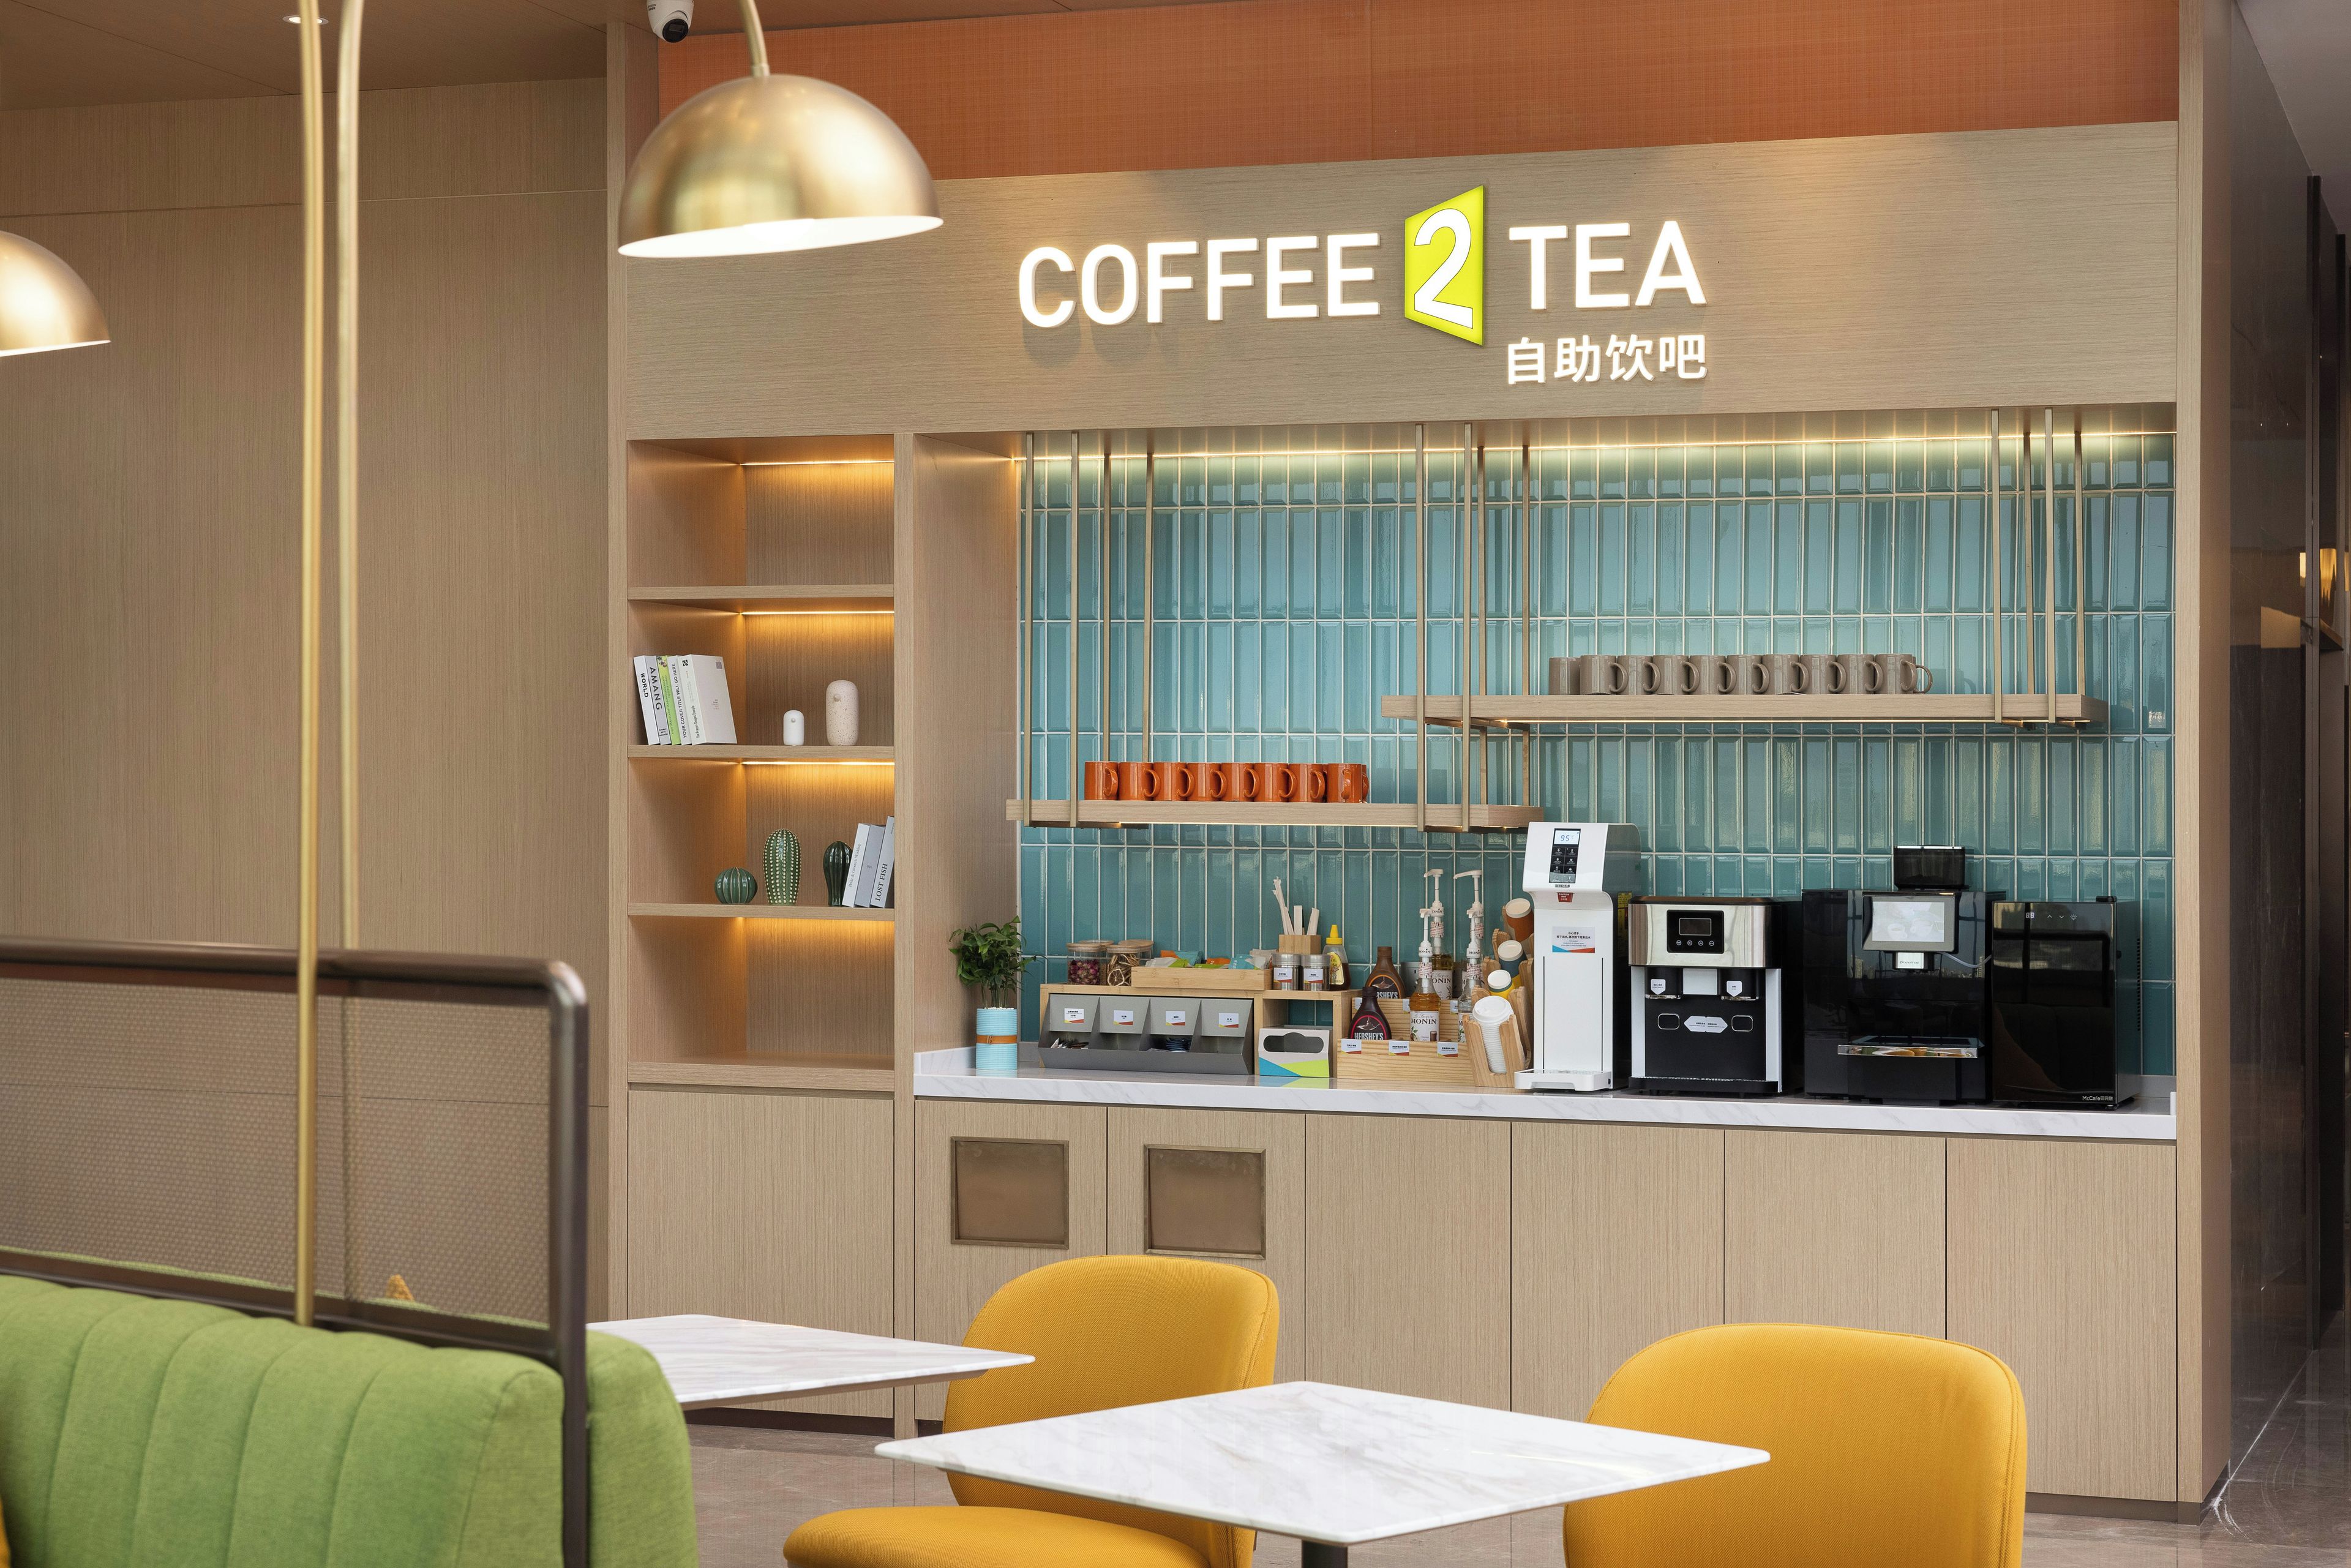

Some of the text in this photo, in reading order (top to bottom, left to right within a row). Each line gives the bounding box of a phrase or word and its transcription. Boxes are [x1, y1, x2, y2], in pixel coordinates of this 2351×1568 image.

[1019, 208, 1708, 329] COFFEE 2 TEA
[1508, 334, 1708, 385] 自助饮吧
[640, 673, 649, 697] WORLD
[650, 667, 662, 710] AMANG
